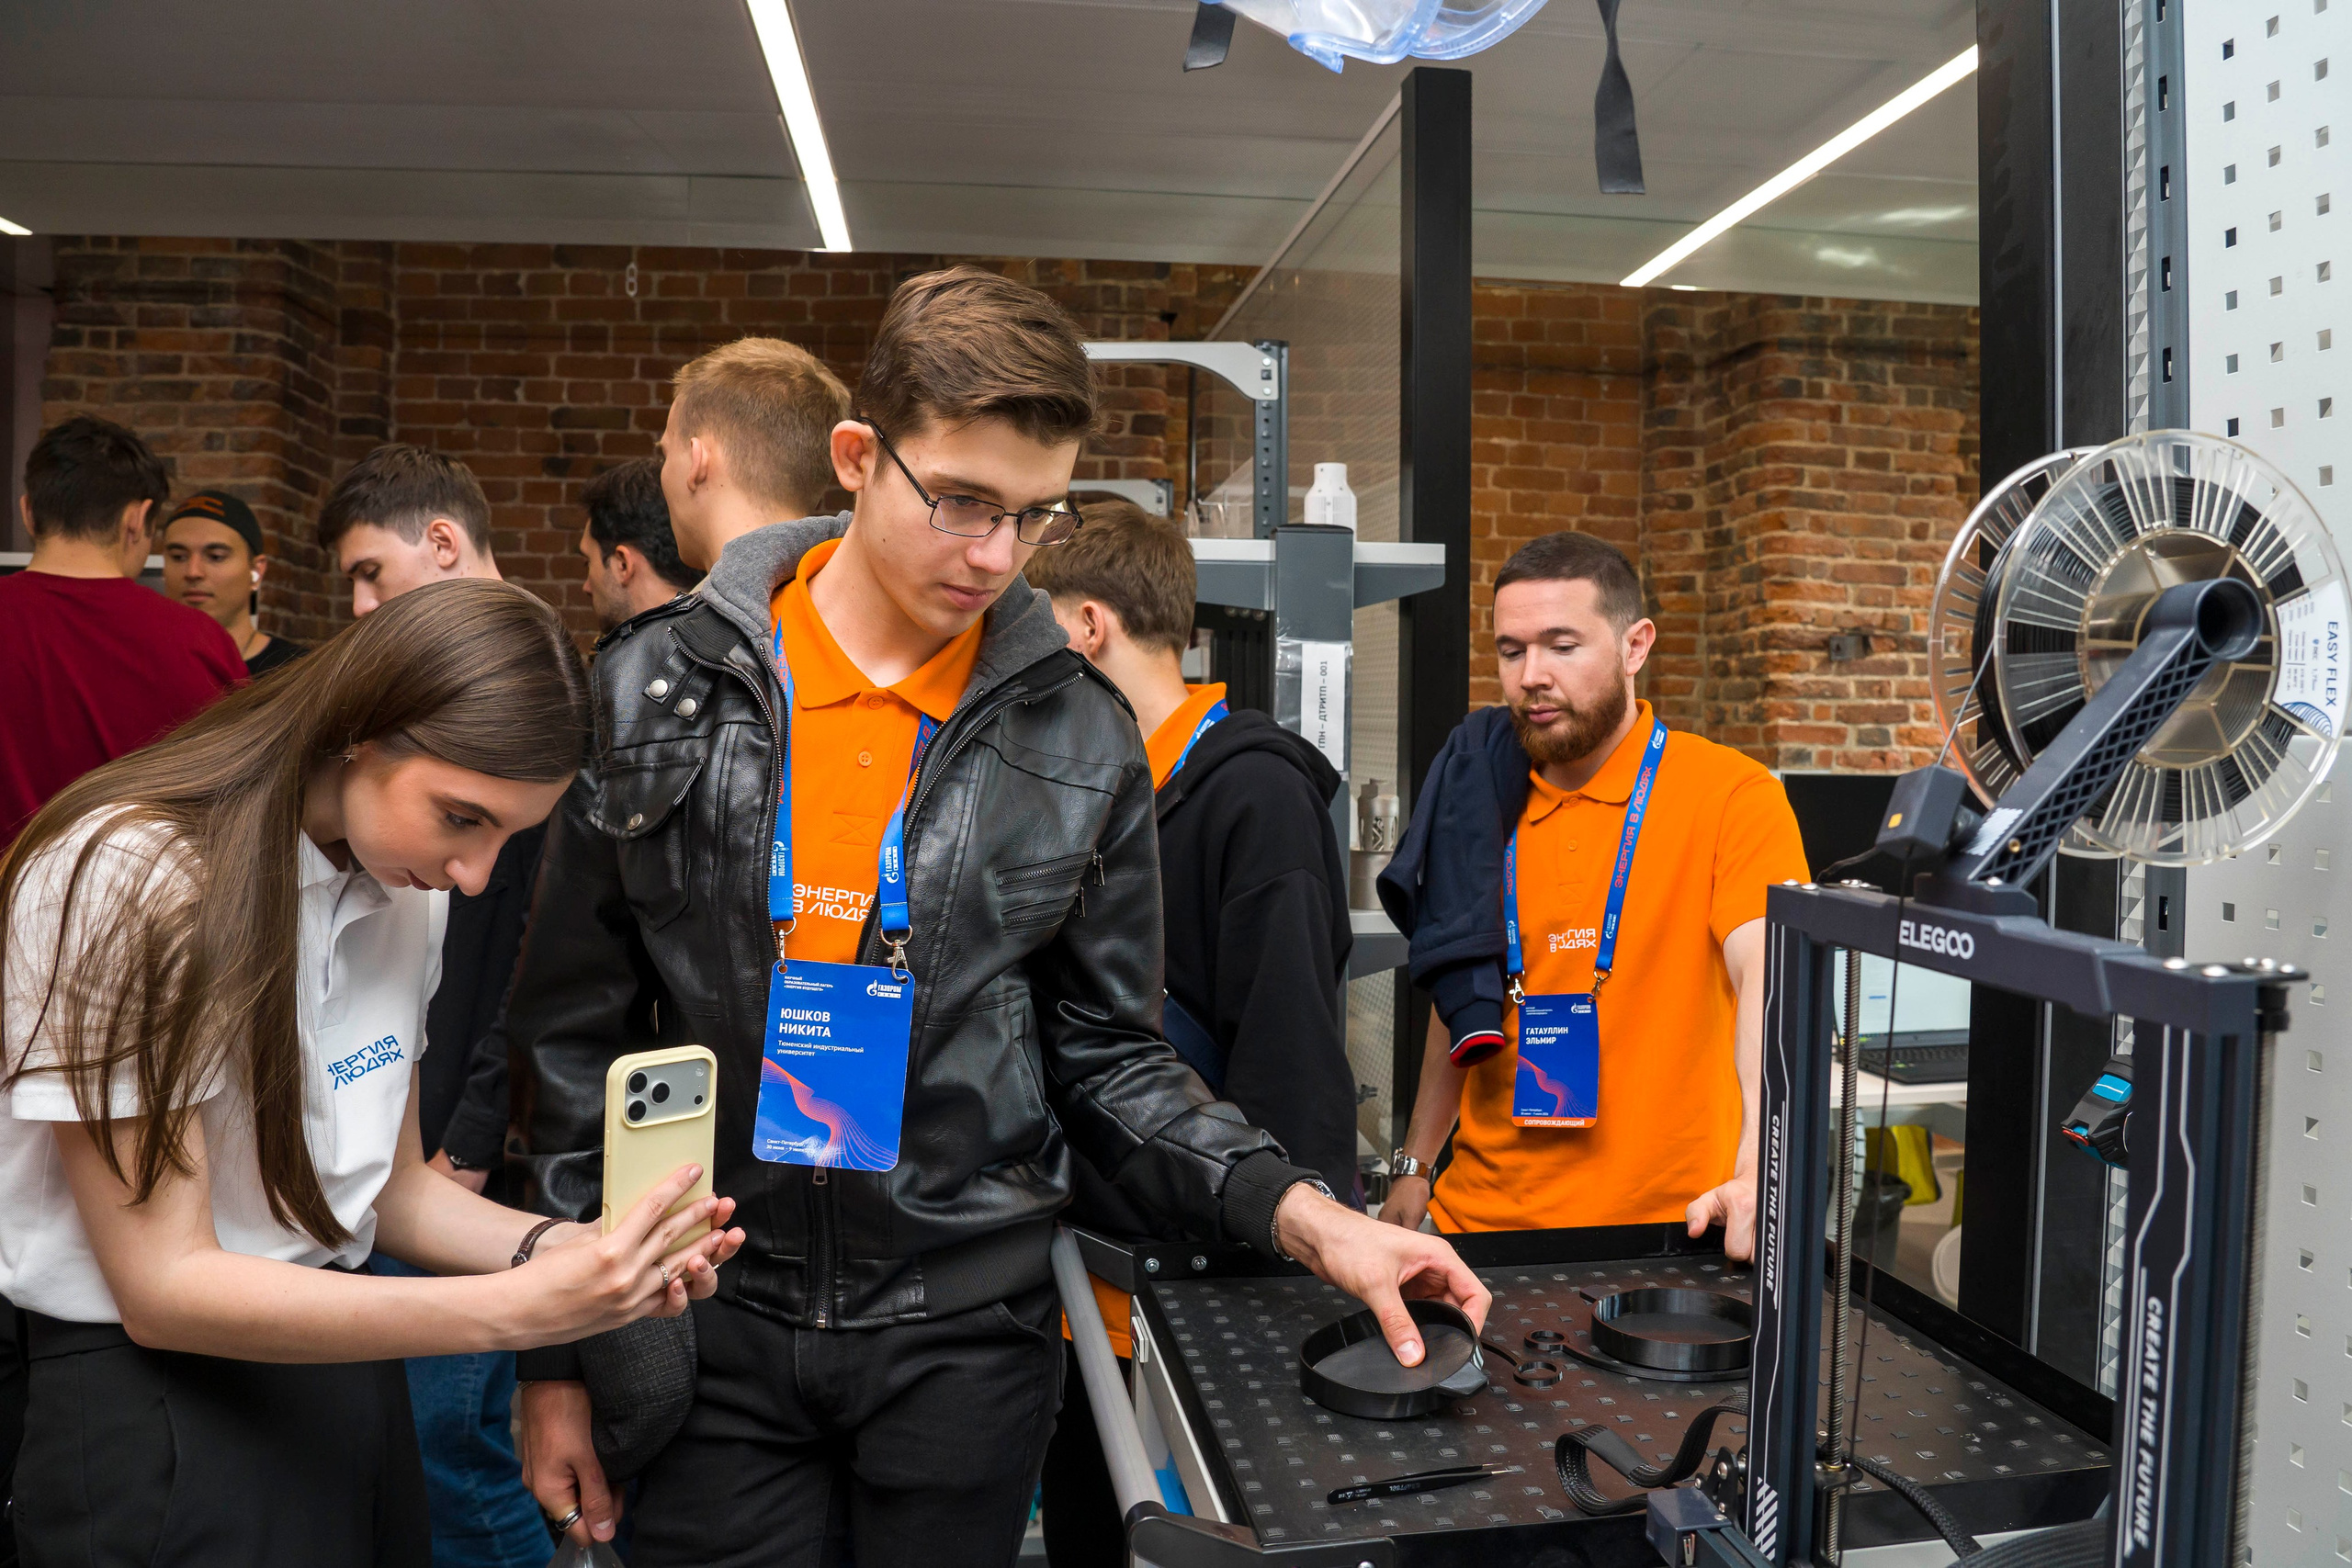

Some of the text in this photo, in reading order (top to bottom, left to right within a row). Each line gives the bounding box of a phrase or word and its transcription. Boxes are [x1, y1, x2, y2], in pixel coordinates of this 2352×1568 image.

[2325, 621, 2338, 706] EASY FLEX
[1318, 685, 1328, 722] ДТРИТП
[1614, 766, 1653, 888] ЭНЕРГИЯ В ЛЮДЯХ
[793, 883, 875, 907] ЭНЕРГИ
[808, 901, 870, 922] ЛЮДЯ
[1898, 919, 1975, 960] ELEGOO
[877, 984, 902, 992] ГАЗПРОМ
[780, 1008, 831, 1022] ЮШКОВ
[778, 1022, 831, 1038] НИКИТА
[1525, 1027, 1568, 1035] ГАТАУЛЛИН
[1525, 1036, 1557, 1045] ЭЛЬМИР
[327, 1034, 399, 1076] НЕРГИЯ
[776, 1048, 816, 1056] университет
[777, 1040, 865, 1054] Тюменский индустриальный
[334, 1047, 405, 1090] ЛЮДЯХ
[1766, 1114, 1781, 1292] CREATE THE FUTURE
[2134, 1296, 2163, 1548] CREATE THE FUTURE
